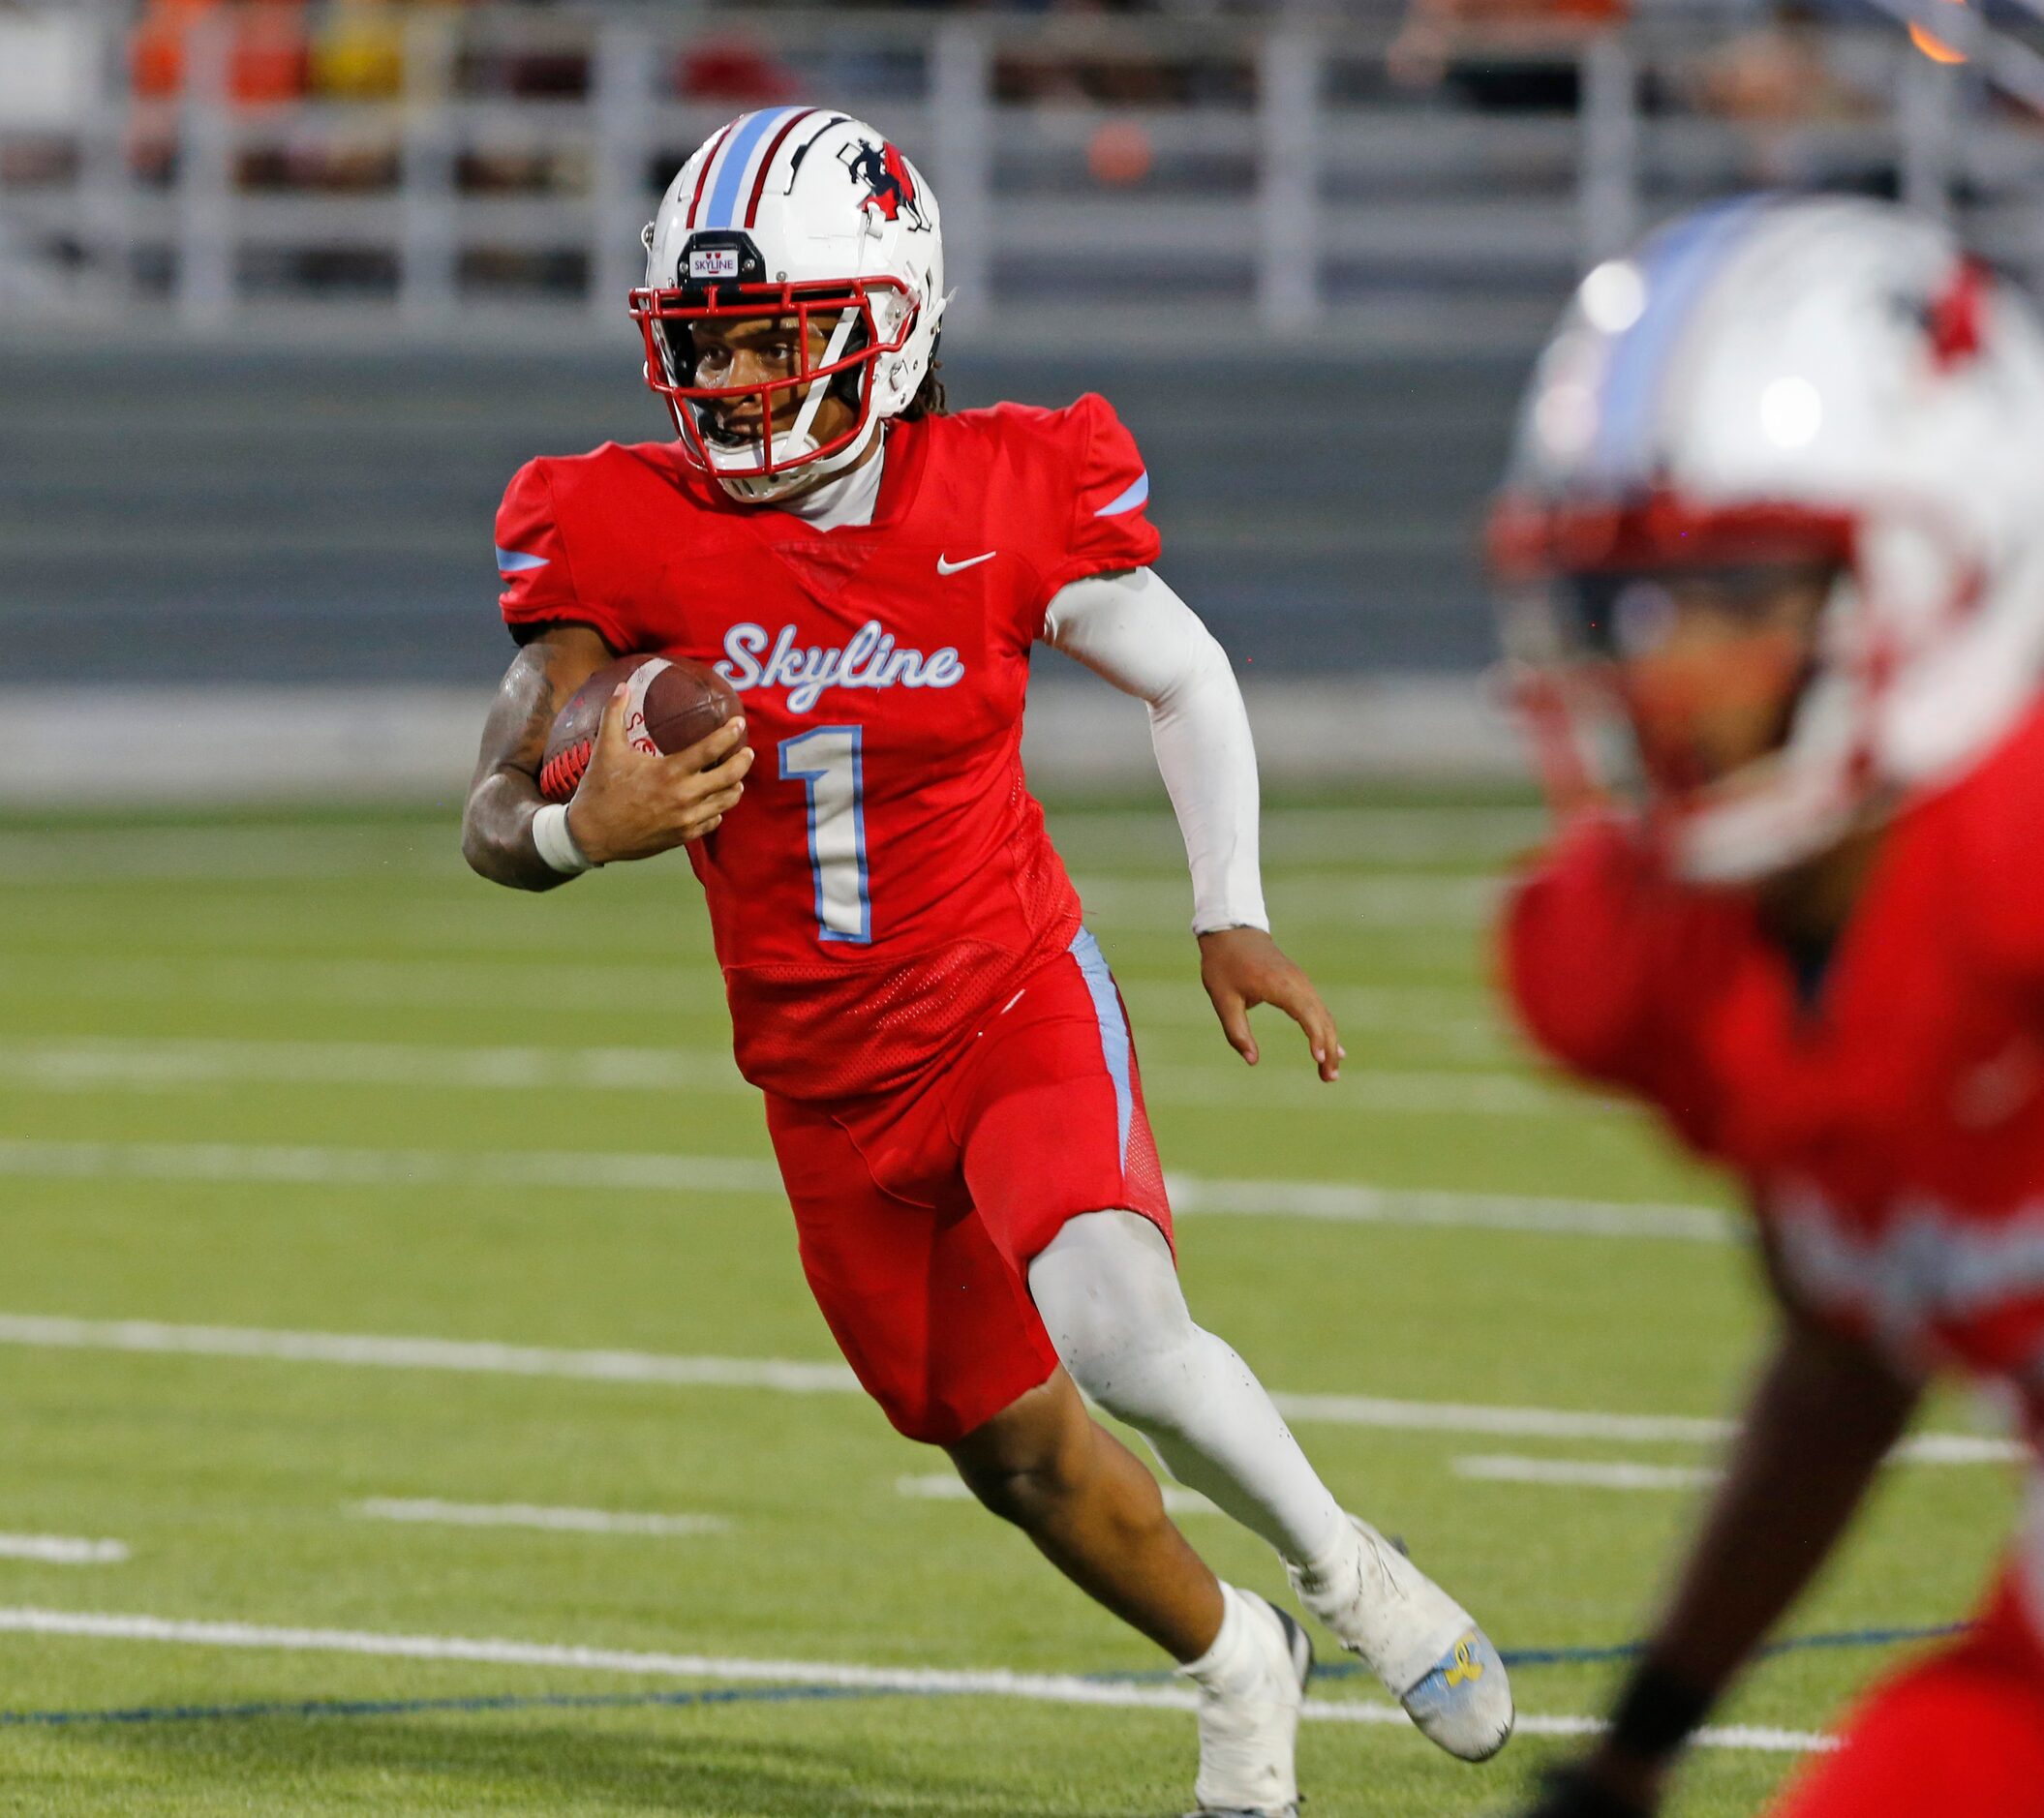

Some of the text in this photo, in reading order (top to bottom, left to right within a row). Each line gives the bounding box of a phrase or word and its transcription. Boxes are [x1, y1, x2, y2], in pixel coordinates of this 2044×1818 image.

[694, 258, 734, 270] SKYLINE
[713, 620, 964, 713] Skyline
[778, 725, 871, 943] 1
